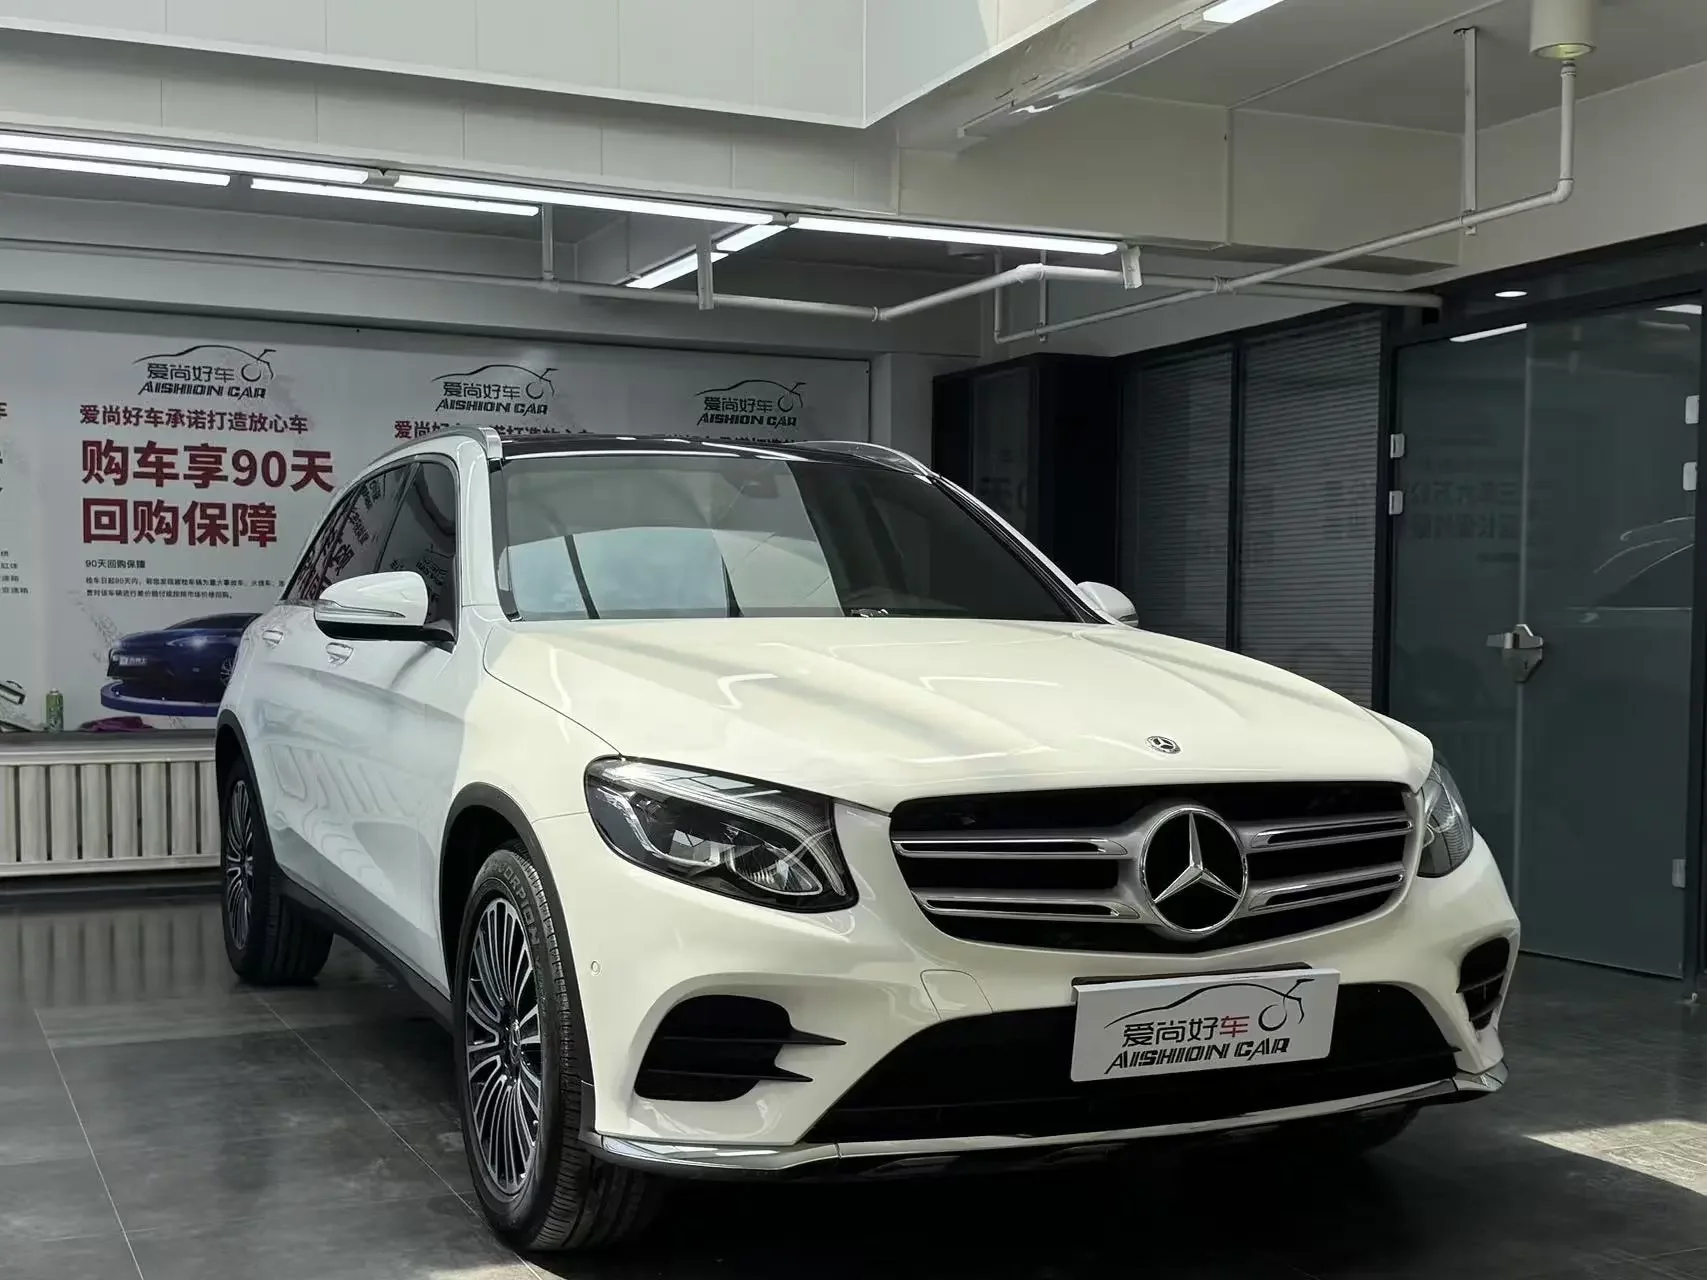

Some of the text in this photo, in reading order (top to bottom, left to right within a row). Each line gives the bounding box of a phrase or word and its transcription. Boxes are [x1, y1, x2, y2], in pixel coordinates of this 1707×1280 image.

[146, 363, 235, 383] 爱尚好车
[138, 381, 267, 400] AISHION CAR
[443, 382, 521, 400] 爱尚好车
[435, 398, 549, 417] AISHION CAR
[703, 397, 773, 414] 爱尚好车
[79, 404, 309, 434] 爱尚好车承诺打造放心车
[696, 412, 798, 429] AISHION CAR
[81, 440, 336, 493] 购车享90天
[82, 498, 278, 548] 回购保障
[1122, 1015, 1250, 1047] 爱尚好车
[1104, 1037, 1291, 1074] AISHION CAR
